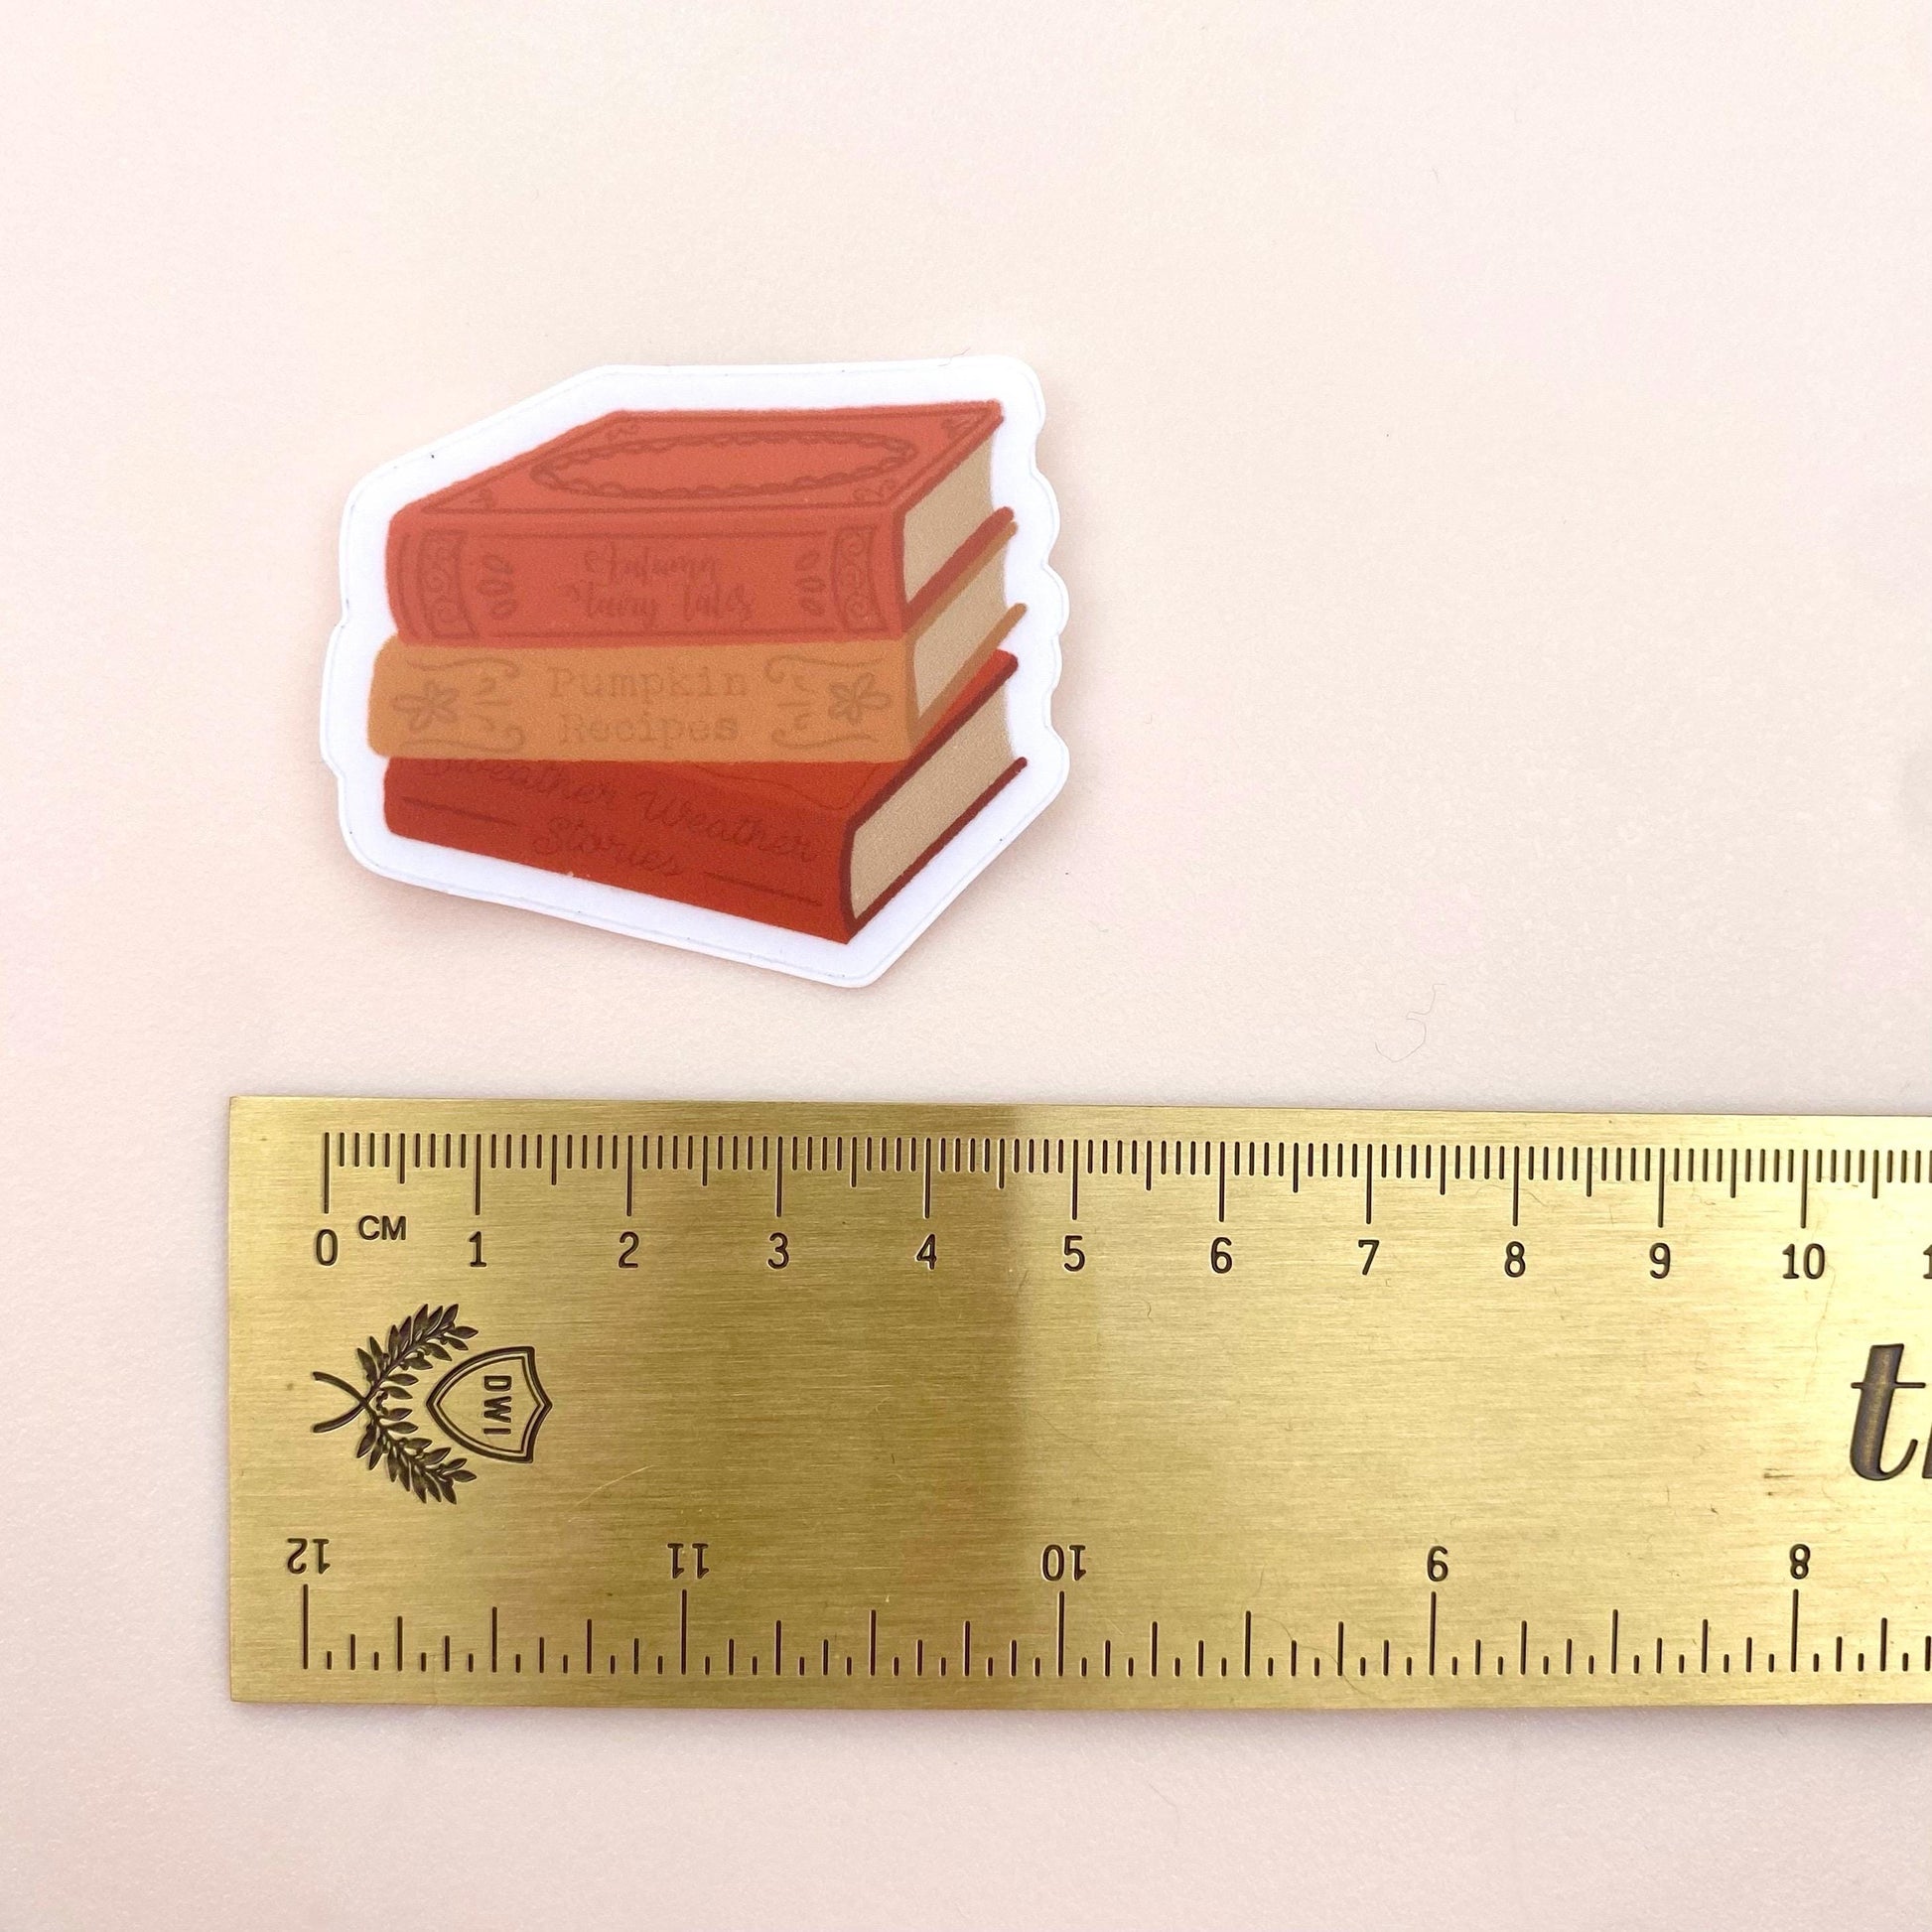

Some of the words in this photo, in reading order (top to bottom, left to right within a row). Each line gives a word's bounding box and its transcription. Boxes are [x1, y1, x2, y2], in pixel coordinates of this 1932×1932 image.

[546, 666, 749, 704] Pumpkin
[559, 709, 741, 750] Recipes
[637, 790, 820, 863] Weather
[531, 816, 681, 878] Stories
[356, 1214, 407, 1241] CM
[313, 1228, 339, 1267] 0
[468, 1230, 487, 1268] 1
[618, 1230, 639, 1269] 2
[767, 1231, 789, 1270] 3
[916, 1233, 937, 1271] 4
[1063, 1234, 1086, 1273] 5
[1210, 1236, 1233, 1275] 6
[1357, 1238, 1381, 1277] 7
[1503, 1240, 1527, 1279] 8
[1648, 1242, 1672, 1280] 9
[1781, 1242, 1827, 1281] 10
[482, 1375, 512, 1436] DWI
